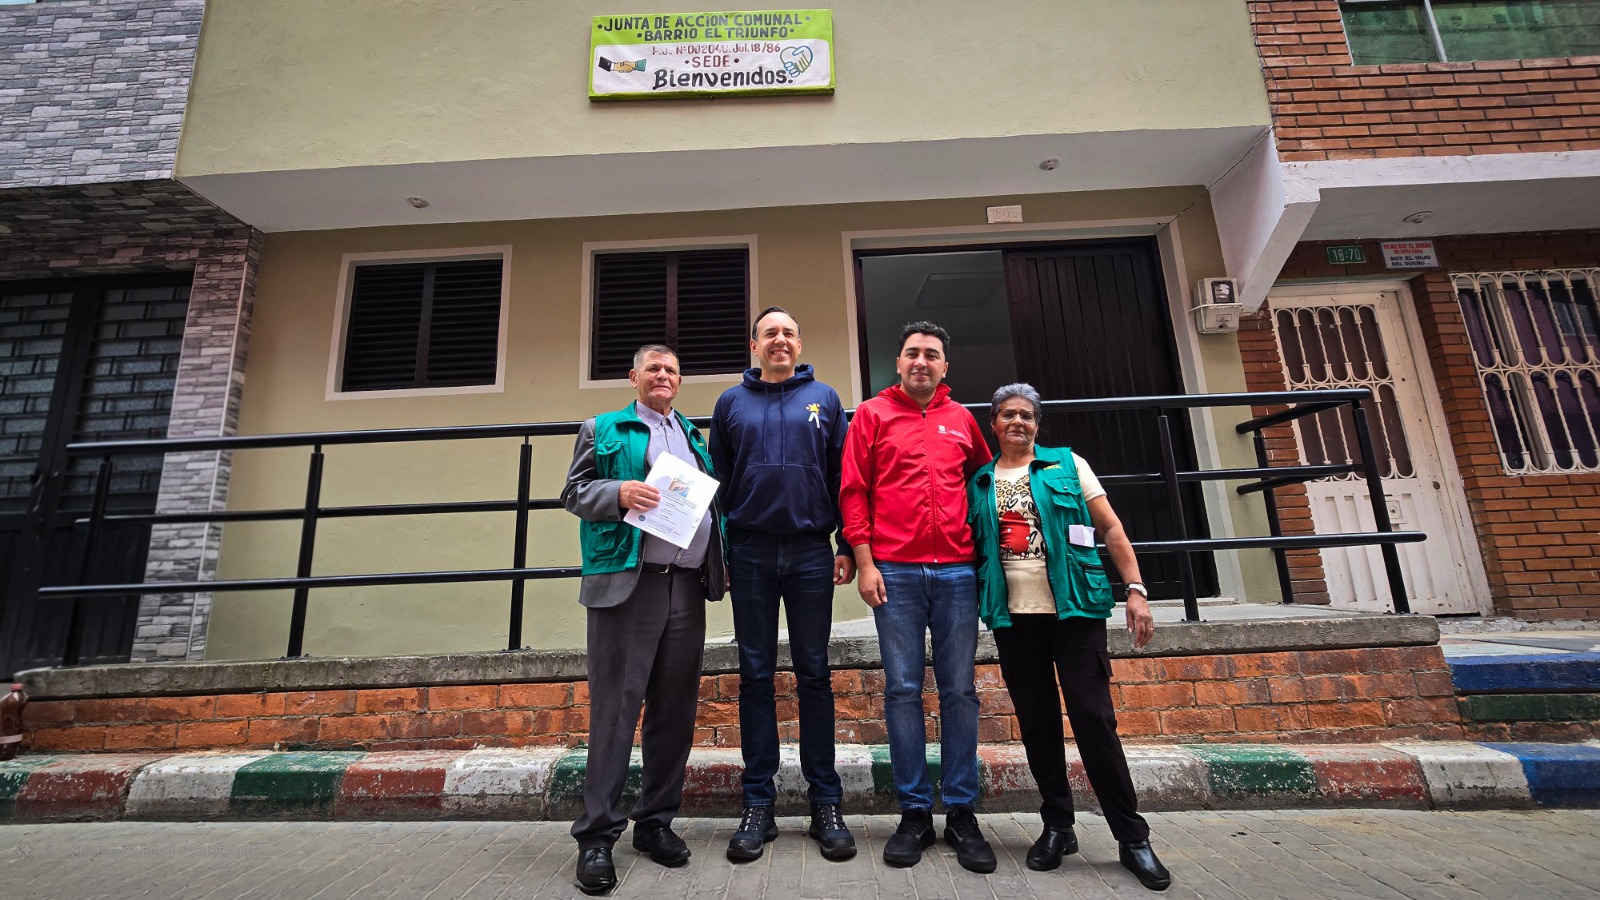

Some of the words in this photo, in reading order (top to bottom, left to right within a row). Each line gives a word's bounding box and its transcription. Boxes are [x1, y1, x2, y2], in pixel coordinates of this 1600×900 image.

[603, 17, 650, 31] JUNTA
[654, 16, 670, 29] DE
[675, 15, 729, 28] ACCION
[733, 13, 803, 27] COMUNAL
[644, 28, 698, 42] BARRIO
[704, 27, 722, 39] EL
[724, 26, 788, 39] TRIUNFO
[691, 55, 731, 68] SEDE
